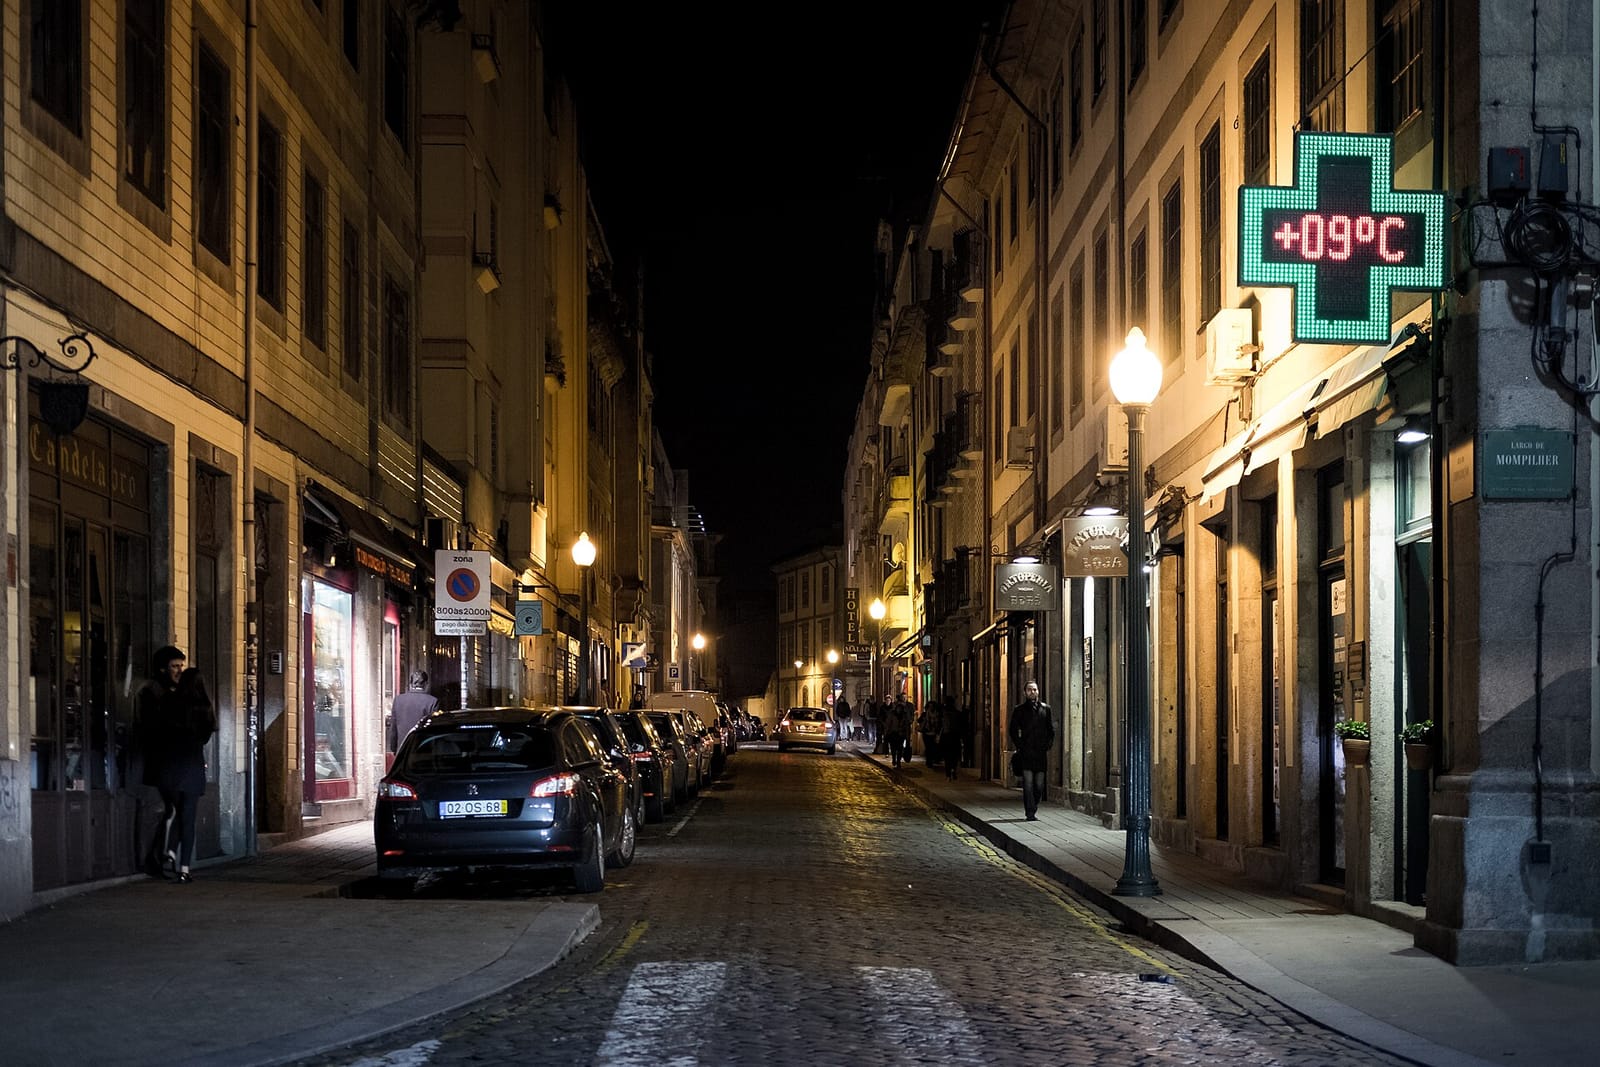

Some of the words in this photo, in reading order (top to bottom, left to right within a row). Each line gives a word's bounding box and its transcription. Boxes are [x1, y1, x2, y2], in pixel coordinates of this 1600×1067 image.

[1511, 441, 1533, 449] LARGO
[1535, 441, 1545, 449] DE
[30, 424, 136, 498] Candelabro
[1496, 454, 1559, 466] MOMPILHER
[847, 590, 856, 642] HOTEL
[671, 668, 677, 677] P
